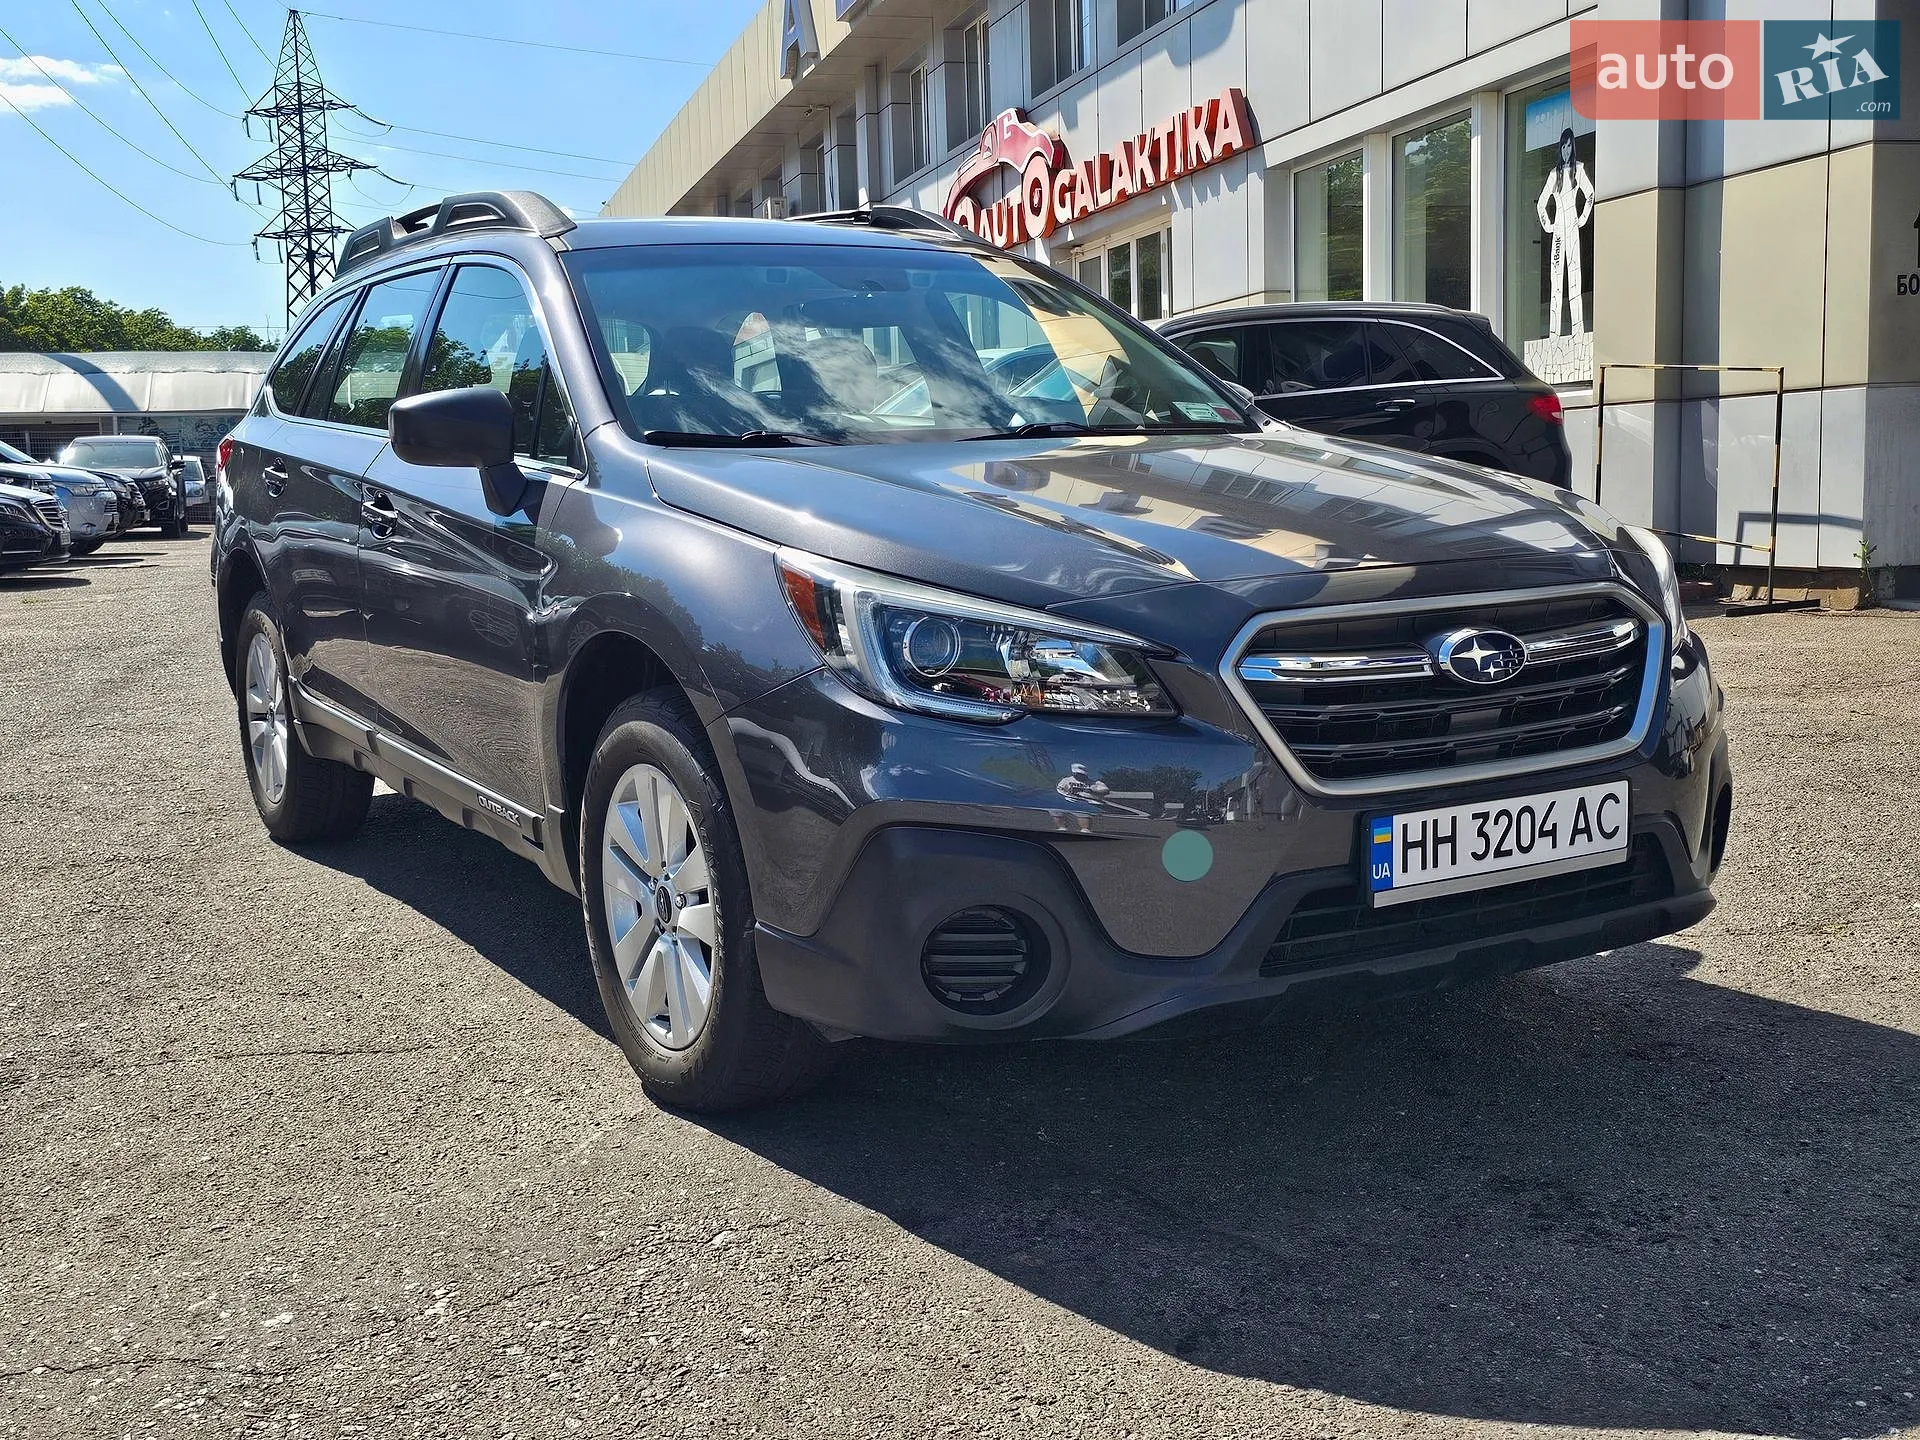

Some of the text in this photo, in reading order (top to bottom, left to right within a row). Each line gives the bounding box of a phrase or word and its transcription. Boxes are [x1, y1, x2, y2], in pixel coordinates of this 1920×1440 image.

[1401, 792, 1621, 874] HH 3204 AC
[1372, 862, 1391, 879] UA
